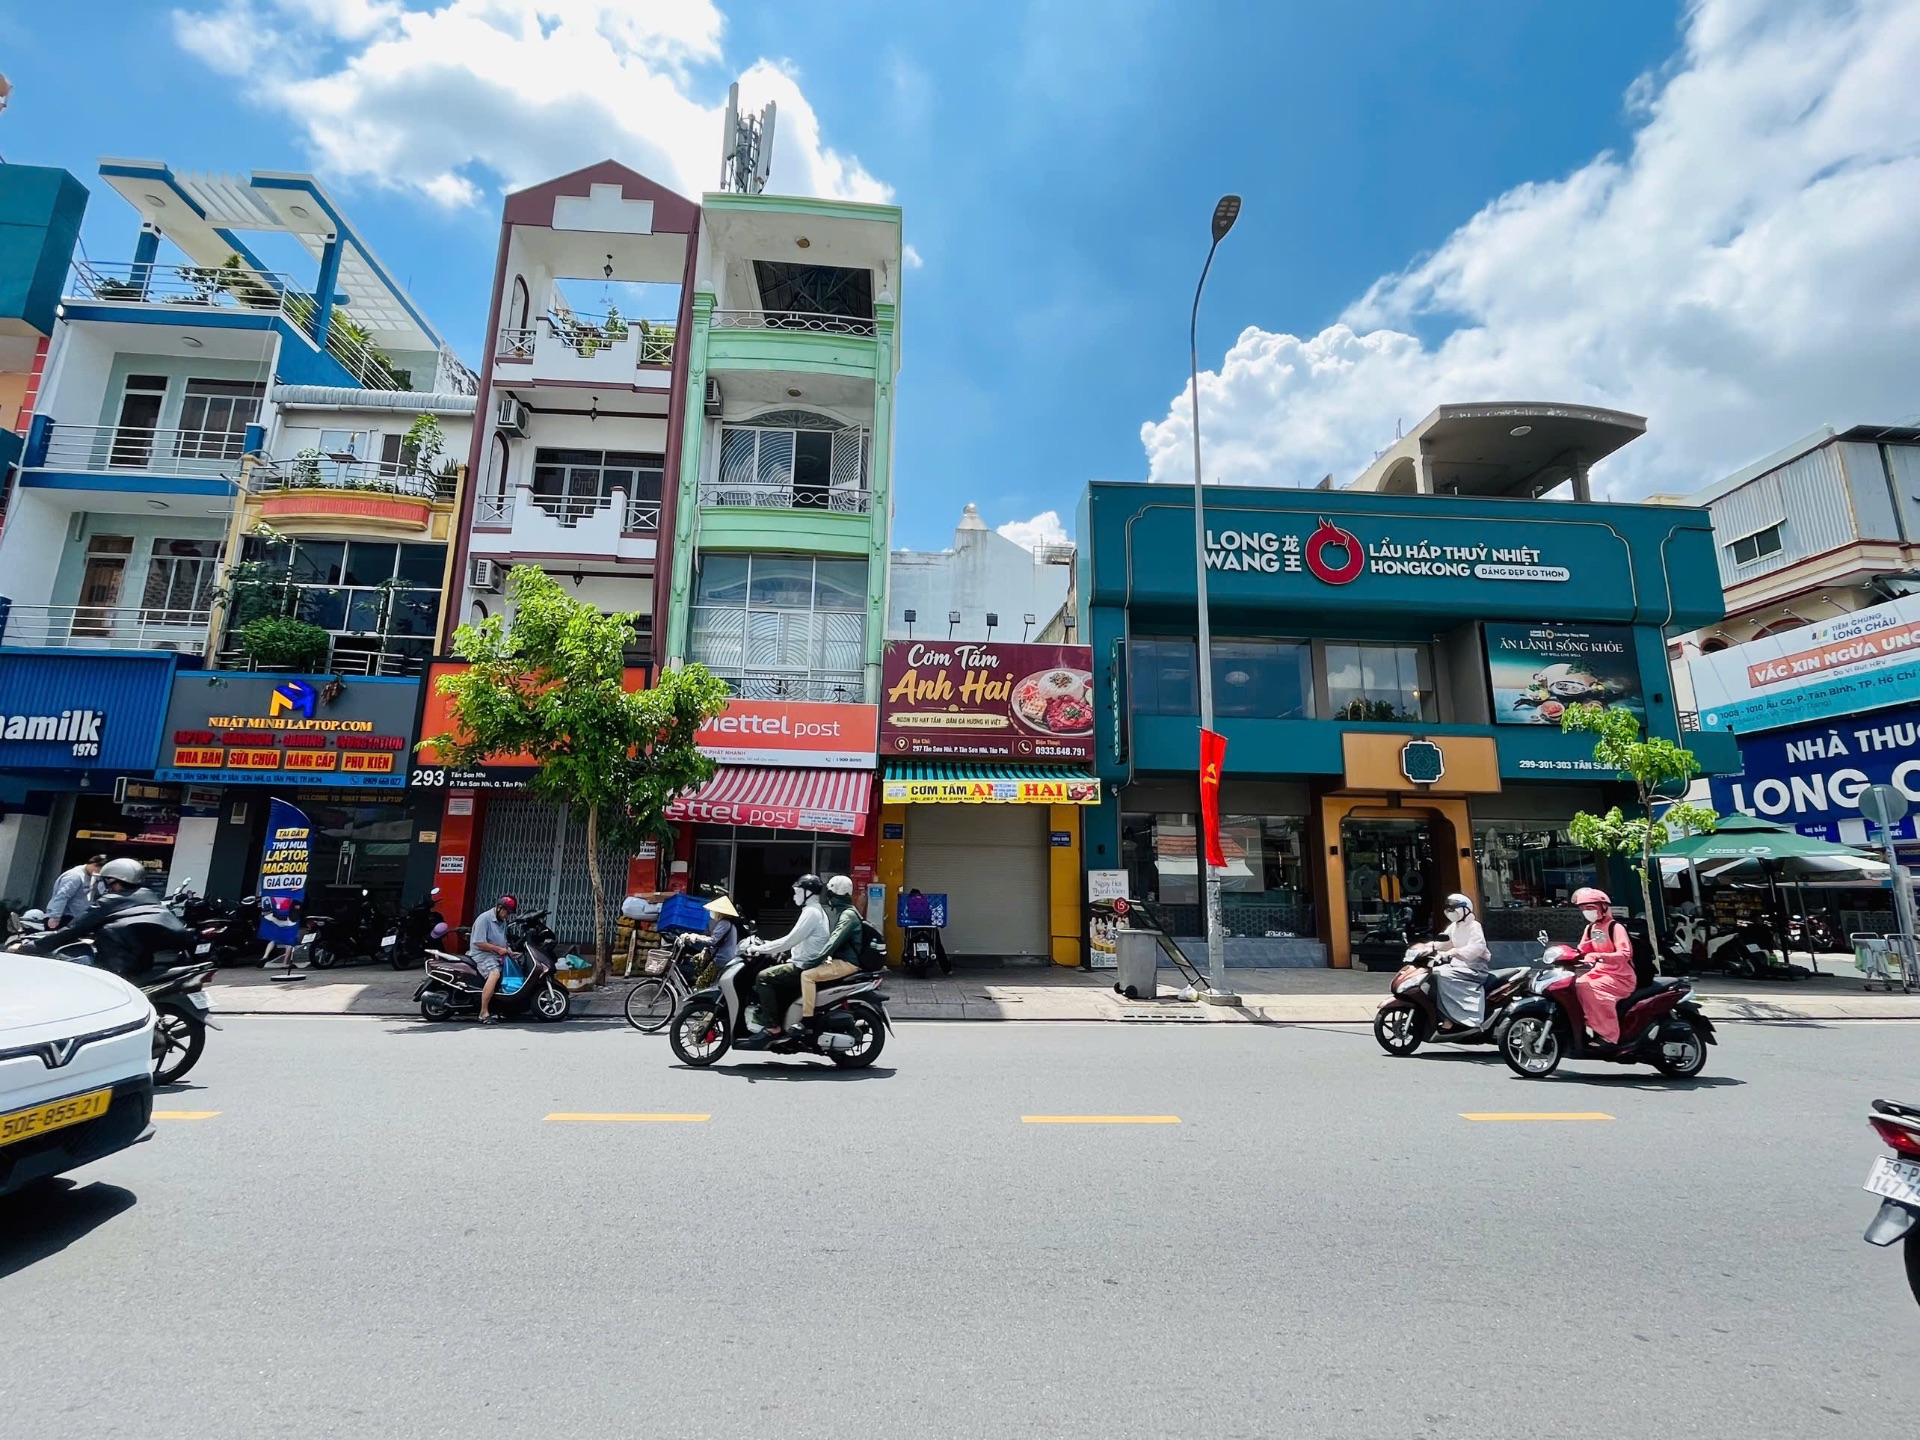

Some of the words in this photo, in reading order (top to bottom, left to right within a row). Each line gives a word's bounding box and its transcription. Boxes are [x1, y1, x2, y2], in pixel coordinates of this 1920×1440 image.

[1206, 530, 1278, 551] LONG
[1369, 536, 1403, 559] LẨU
[1406, 539, 1444, 560] HẤP
[1492, 545, 1540, 566] NHIỆT
[1203, 551, 1280, 573] WANG
[1371, 559, 1470, 577] HONGKONG
[1481, 567, 1506, 577] DÁNG
[1508, 568, 1525, 579] ĐẸP
[1527, 569, 1537, 577] EO
[1539, 569, 1564, 579] THON
[1831, 623, 1848, 631] TIÊM
[1833, 627, 1862, 640] LONG
[1864, 617, 1897, 632] CHÂU
[1500, 638, 1517, 649] ĂN
[1520, 638, 1552, 651] LÀNH
[1555, 638, 1588, 652] SỐNG
[1591, 641, 1623, 653] KHỎE
[907, 643, 953, 667] Cơm
[954, 645, 1000, 670] Tấm
[1755, 663, 1788, 682] VẮC
[1790, 656, 1821, 673] XIN
[1824, 642, 1878, 665] NGỪA
[888, 669, 955, 705] Anh
[959, 669, 1014, 705] Hai
[1797, 694, 1807, 703] P.
[1857, 680, 1876, 690] TP.
[0, 710, 102, 741] amilk
[208, 715, 247, 731] NHẬT
[247, 718, 285, 729] MINH
[286, 719, 373, 732] LAPTOP.COM
[794, 720, 841, 738] post
[72, 743, 98, 757] 1976
[1785, 729, 1849, 763] NHÀ
[1854, 722, 1920, 752] THU
[176, 751, 199, 764] MUA
[201, 750, 221, 764] BÁN
[315, 752, 335, 767] CẤP
[345, 756, 364, 770] PHỤ
[367, 755, 390, 770] KIỆN
[1519, 760, 1572, 769] 299-301-303
[1572, 759, 1592, 769] TÂN
[411, 769, 445, 787] 293
[911, 785, 938, 795] CƠM
[941, 783, 966, 795] TẤM
[1024, 783, 1063, 796] HAI
[1732, 768, 1871, 816] LONG
[661, 801, 742, 821] iettel
[749, 809, 794, 824] post
[272, 841, 289, 850] THU
[289, 841, 307, 849] MUA
[265, 850, 309, 862] LAPTOP,
[262, 862, 309, 874] MACBOOK
[266, 876, 281, 888] GIÁ
[283, 877, 302, 887] CAO
[2, 1096, 100, 1138] 50E-855.21
